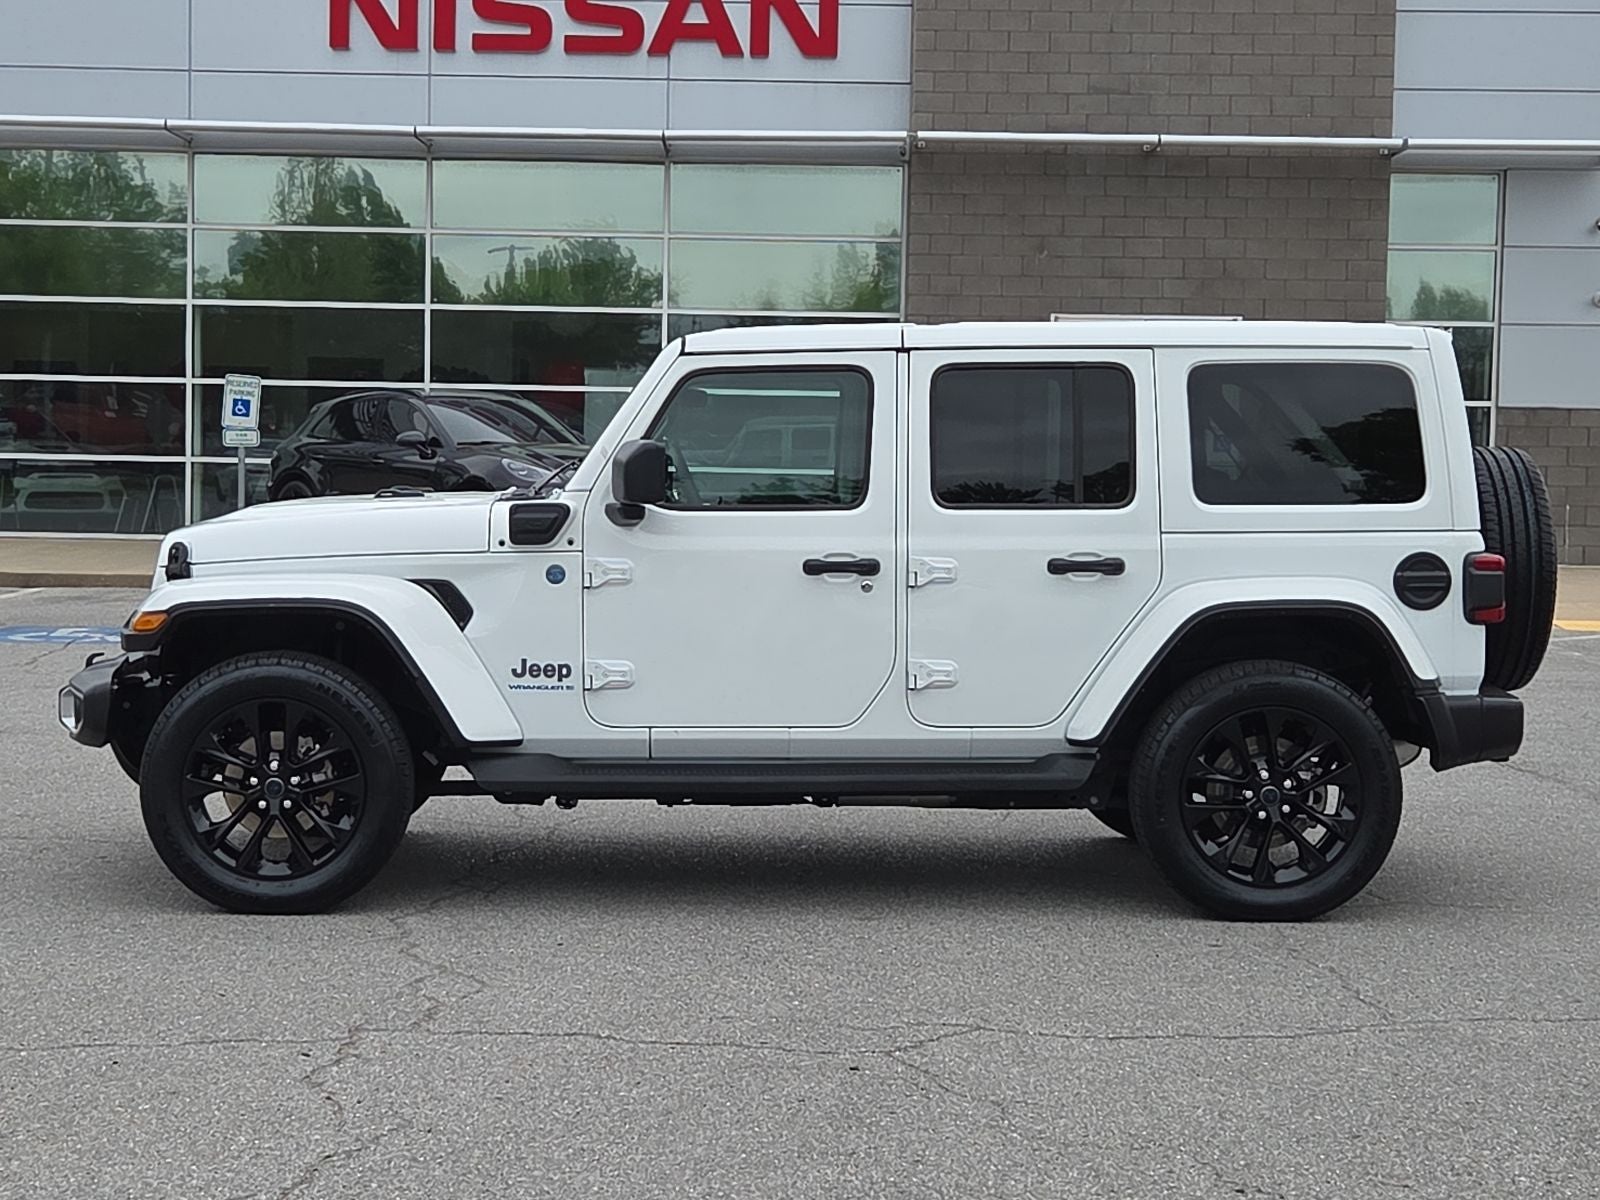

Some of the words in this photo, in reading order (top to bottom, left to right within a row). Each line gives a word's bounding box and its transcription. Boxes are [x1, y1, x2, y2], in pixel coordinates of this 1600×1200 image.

[329, 0, 838, 59] NISSAN
[226, 379, 258, 389] RESERVED
[229, 389, 256, 398] PARKING
[511, 658, 572, 682] Jeep
